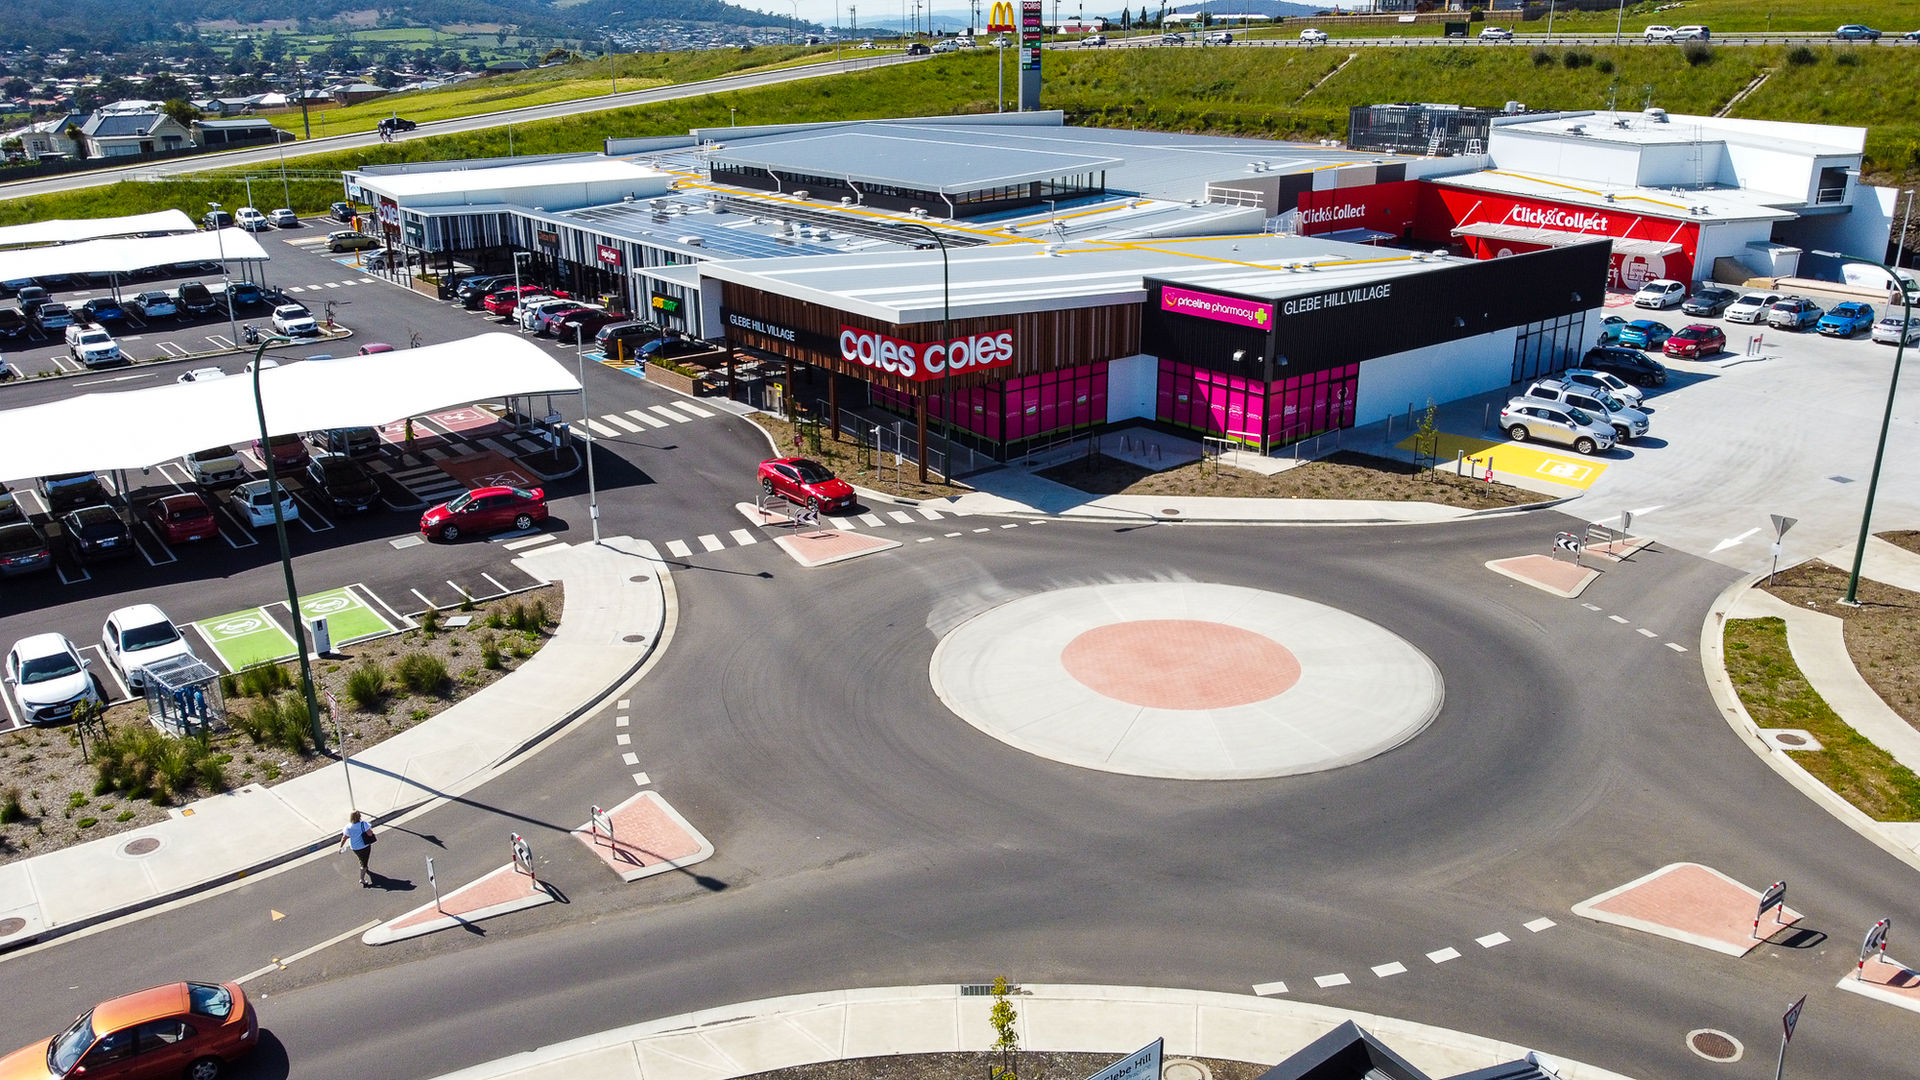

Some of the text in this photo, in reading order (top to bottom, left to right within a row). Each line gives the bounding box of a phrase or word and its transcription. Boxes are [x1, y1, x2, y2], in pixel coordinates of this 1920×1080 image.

[1302, 204, 1366, 224] Click&Collect
[1512, 206, 1608, 231] Click&Collect
[1177, 297, 1254, 321] priceline pharmacy
[1284, 284, 1391, 315] GLEBE HILL VILLAGE
[729, 314, 795, 341] GLEBE HILL VILLAGE
[840, 330, 917, 378] coles
[923, 333, 1013, 374] coles
[1134, 1053, 1151, 1069] Hill
